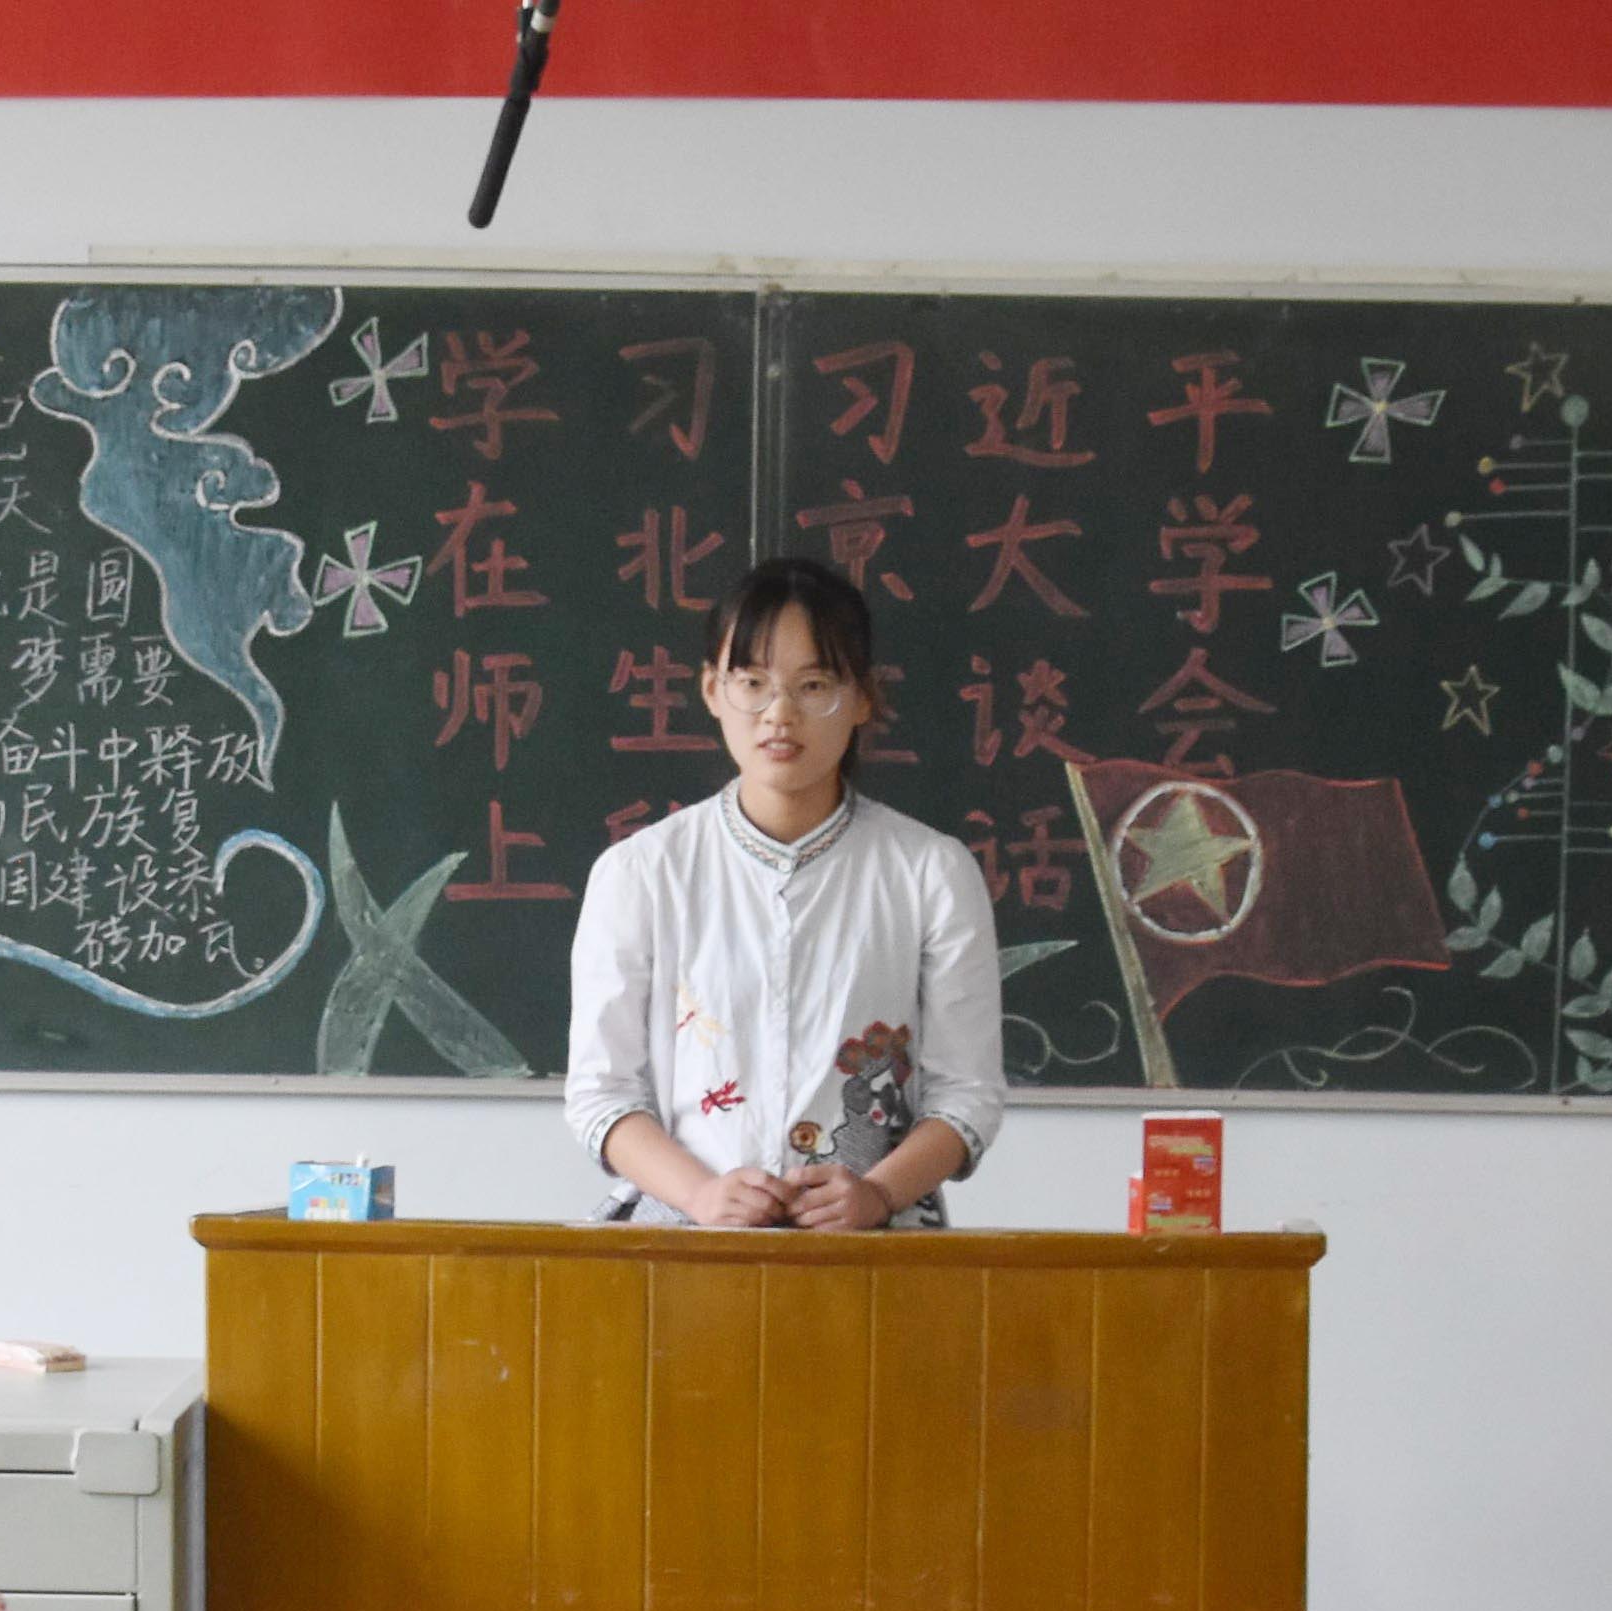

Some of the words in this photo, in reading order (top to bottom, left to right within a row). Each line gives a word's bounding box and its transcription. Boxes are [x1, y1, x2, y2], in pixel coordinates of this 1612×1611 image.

[428, 328, 1275, 474] 学习习近平
